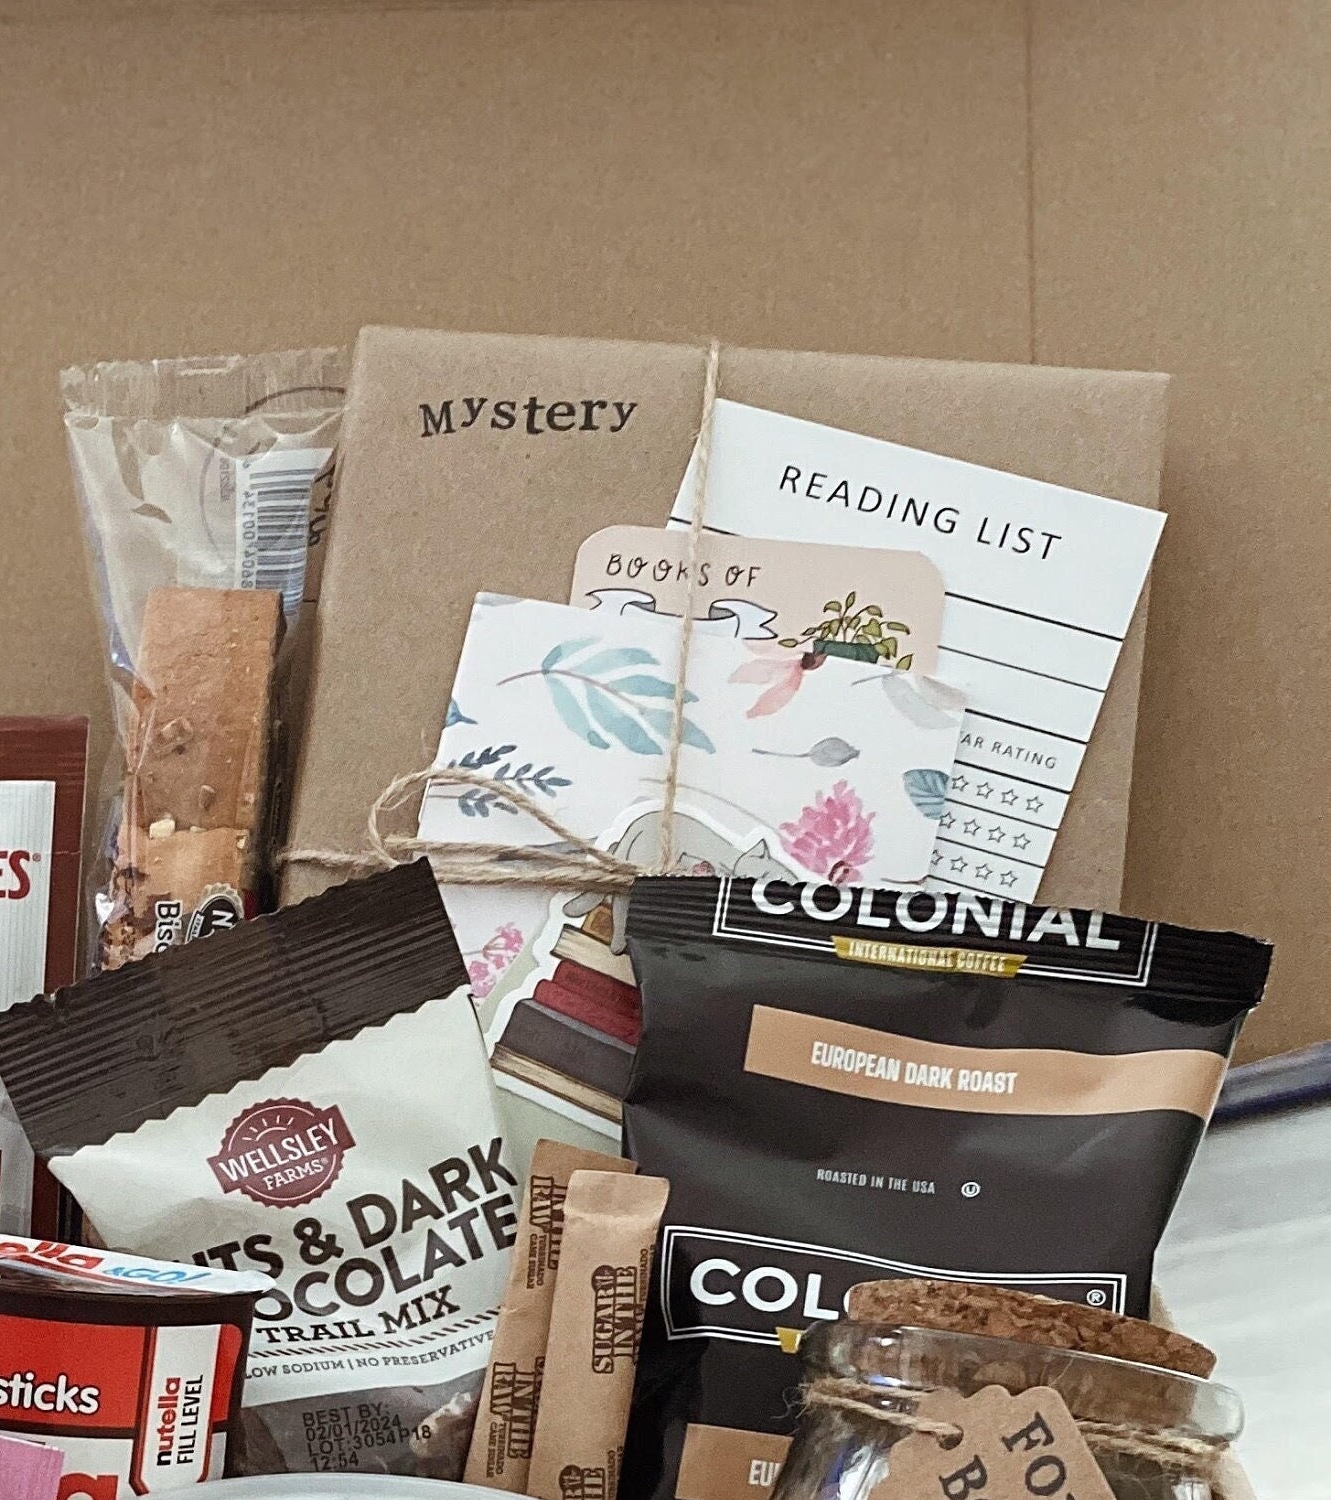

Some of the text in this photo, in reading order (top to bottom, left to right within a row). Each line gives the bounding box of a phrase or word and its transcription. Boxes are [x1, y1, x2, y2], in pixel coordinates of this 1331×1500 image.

[419, 396, 638, 438] Mystery
[778, 465, 1062, 560] READING LIST
[606, 553, 761, 588] BOOKS OF
[960, 733, 1059, 770] AR RATING
[751, 882, 1121, 951] COLONIAL
[849, 941, 1005, 973] INTERNATIONAL COFFEE
[811, 1041, 1018, 1094] EUROPEAN DARK ROAST
[219, 1118, 339, 1184] WELLSLEY
[817, 1168, 936, 1194] ROASTED IN THE USA
[191, 1137, 518, 1279] TS & DARK
[254, 1194, 520, 1322] OCOLATE
[257, 1285, 461, 1343] TRAIL MIX
[614, 1267, 637, 1357] IN THE
[690, 1258, 853, 1321] COL
[283, 1359, 344, 1375] SODIUM
[356, 1357, 379, 1368] NO
[382, 1330, 495, 1366] PRESERVATIVE
[593, 1287, 614, 1374] SUGAR
[157, 1377, 179, 1466] nutella
[176, 1374, 204, 1464] FILL LEVEL
[303, 1401, 390, 1428] BEST BY:
[306, 1414, 402, 1441] 02/01/2024
